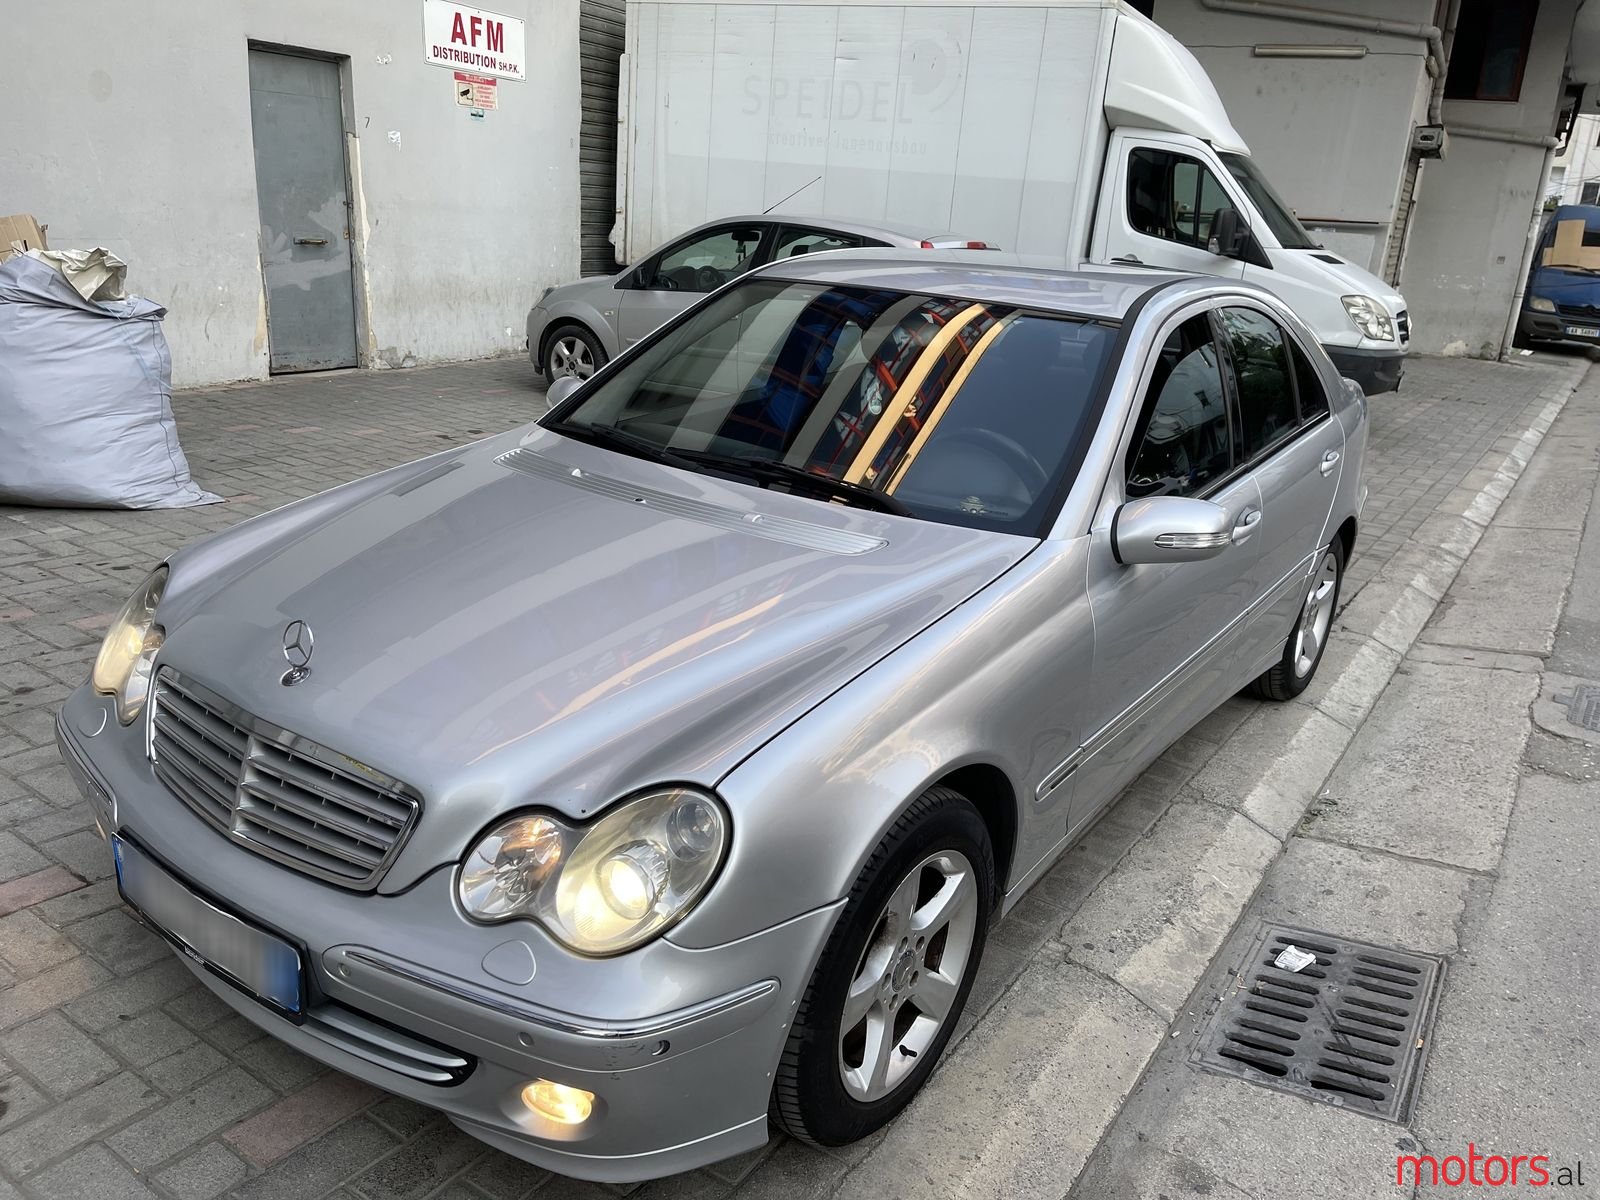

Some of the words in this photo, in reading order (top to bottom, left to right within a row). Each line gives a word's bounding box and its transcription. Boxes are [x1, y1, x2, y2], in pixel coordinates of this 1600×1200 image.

[451, 12, 504, 53] AFM
[433, 45, 496, 69] DISTRIBUTION
[498, 61, 520, 74] SH.P.K.
[742, 74, 913, 124] SPEIDEL
